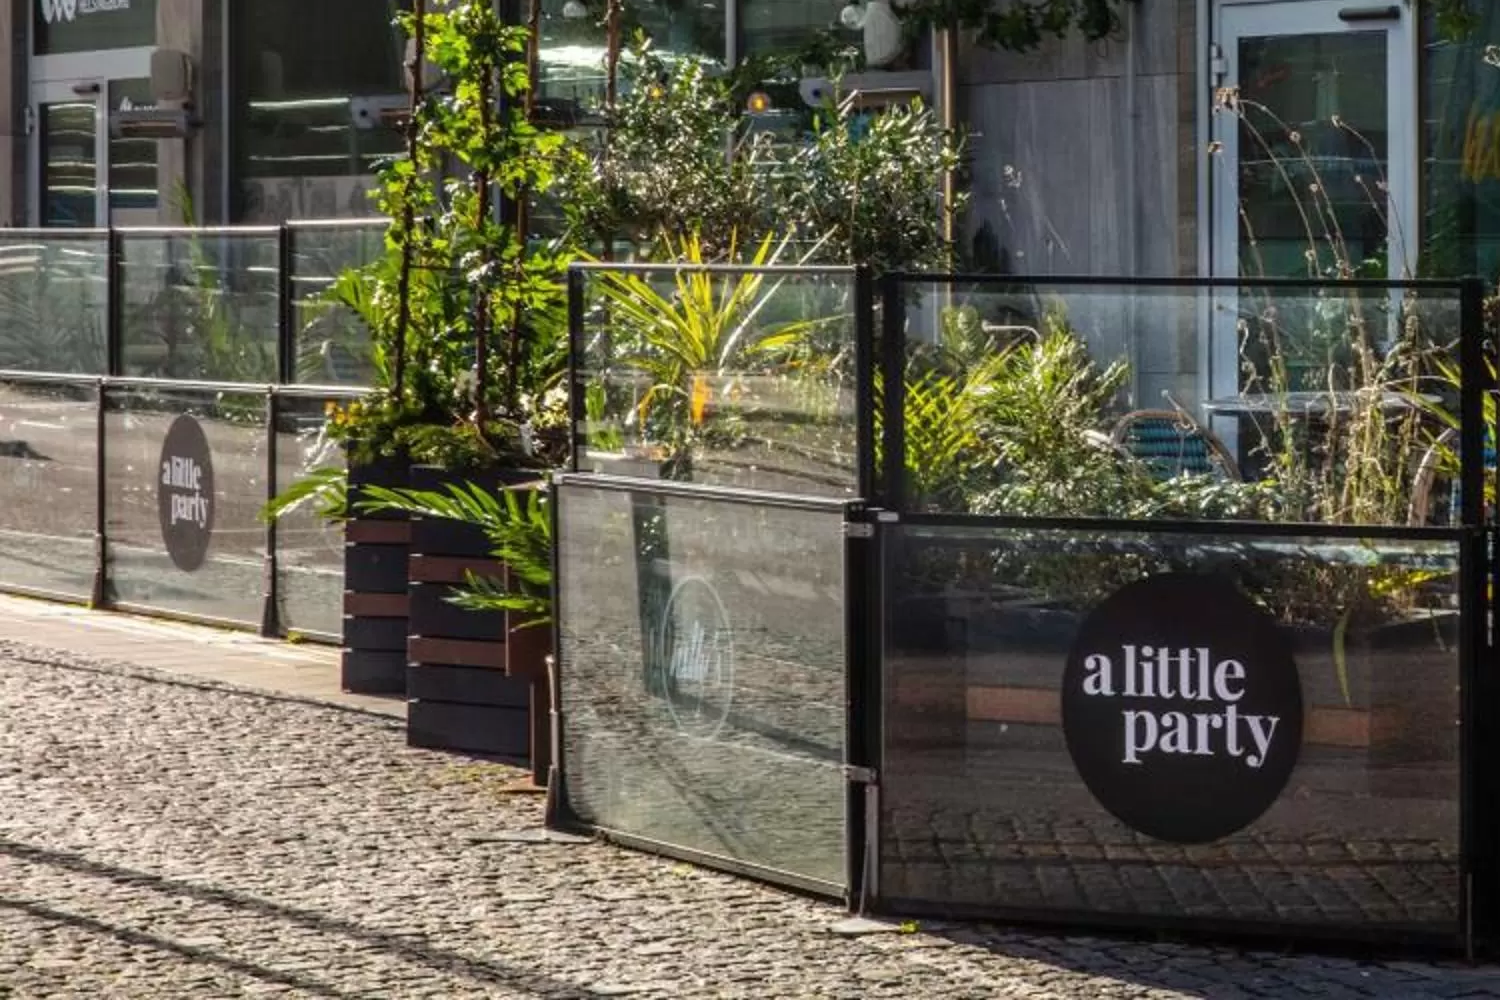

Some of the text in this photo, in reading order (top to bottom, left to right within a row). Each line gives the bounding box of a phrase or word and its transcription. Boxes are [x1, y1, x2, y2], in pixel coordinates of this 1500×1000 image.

[162, 455, 202, 490] a little
[171, 492, 208, 529] party
[1082, 644, 1247, 702] a little
[1121, 703, 1281, 769] party
